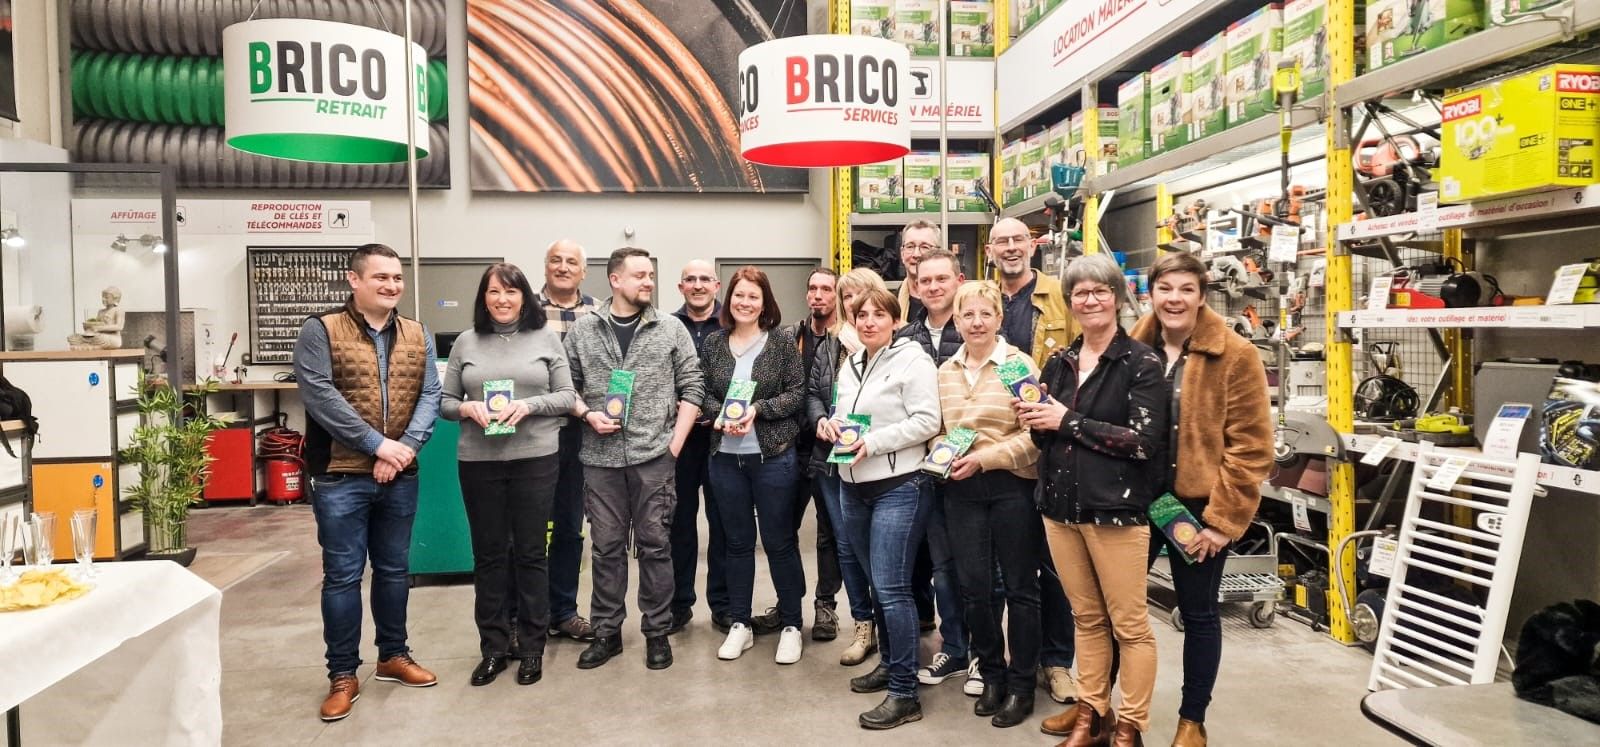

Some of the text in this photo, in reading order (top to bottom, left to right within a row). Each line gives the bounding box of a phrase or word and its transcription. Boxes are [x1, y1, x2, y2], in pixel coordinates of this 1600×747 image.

[1053, 11, 1096, 58] LOCATION
[248, 40, 387, 101] BRICO
[416, 64, 426, 113] B
[786, 54, 898, 108] BRICO
[316, 99, 387, 120] RETRAIT
[843, 107, 899, 126] SERVICES
[921, 102, 982, 117] MAÉRIEL
[1443, 97, 1481, 120] RYOBI
[110, 208, 157, 220] AFFÛTAGE
[251, 203, 322, 212] REPRODUCTION
[274, 211, 322, 220] DE CLÉS ET
[1390, 221, 1397, 229] et
[1438, 210, 1465, 222] outillage
[1468, 209, 1476, 217] et
[1477, 205, 1506, 217] matériel
[1508, 199, 1549, 213] d'occasion
[247, 220, 323, 229] TÉLÉCOMMANDES
[1420, 315, 1436, 323] votre
[1438, 314, 1466, 325] outillage
[1468, 315, 1476, 323] et
